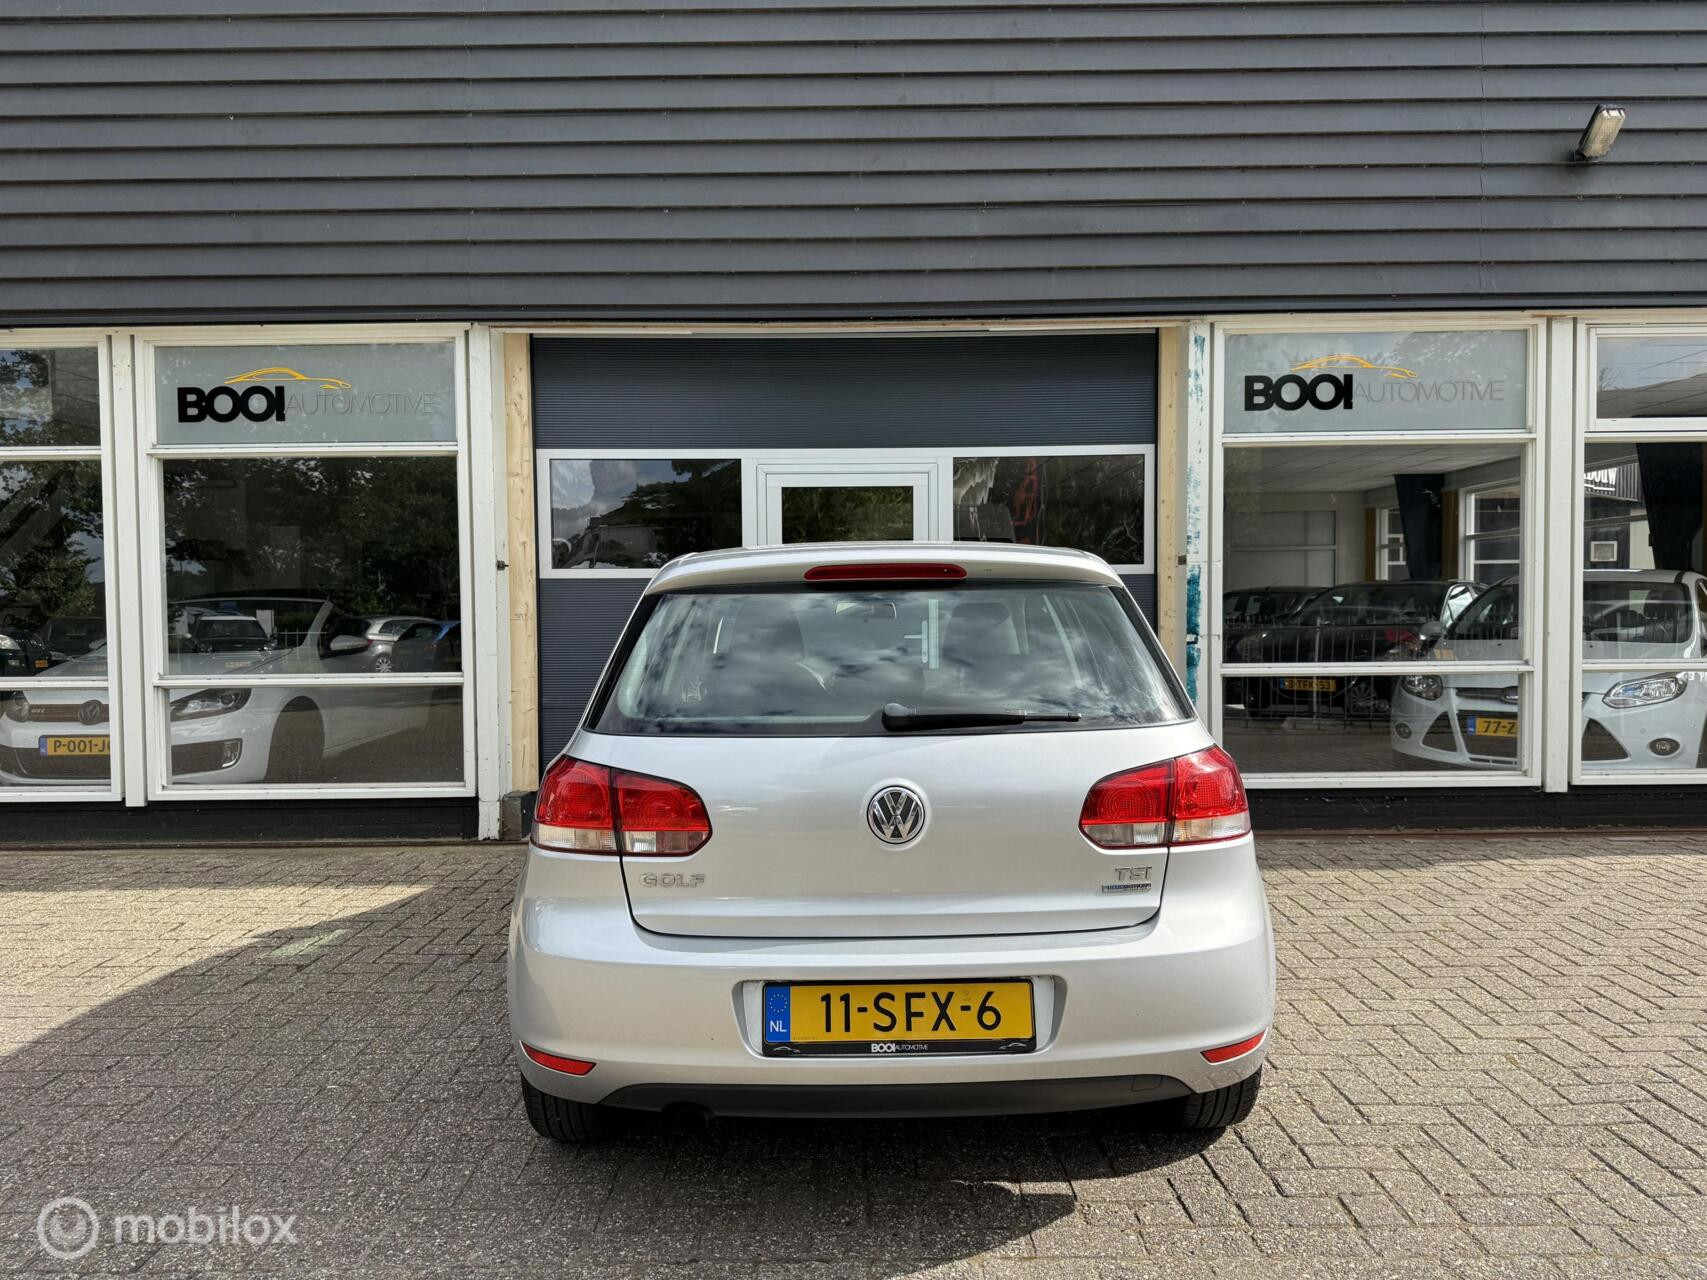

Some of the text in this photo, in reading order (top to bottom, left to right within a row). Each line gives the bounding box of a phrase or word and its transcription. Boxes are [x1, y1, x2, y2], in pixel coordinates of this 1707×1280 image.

[177, 385, 436, 422] BOOI AUTOMOTIVE
[1244, 373, 1505, 411] BOOI AUTOMOTIVE
[640, 873, 706, 888] GOLF
[1115, 866, 1152, 880] TSI
[820, 991, 1002, 1033] 11-SFX-6
[770, 1019, 788, 1033] NL
